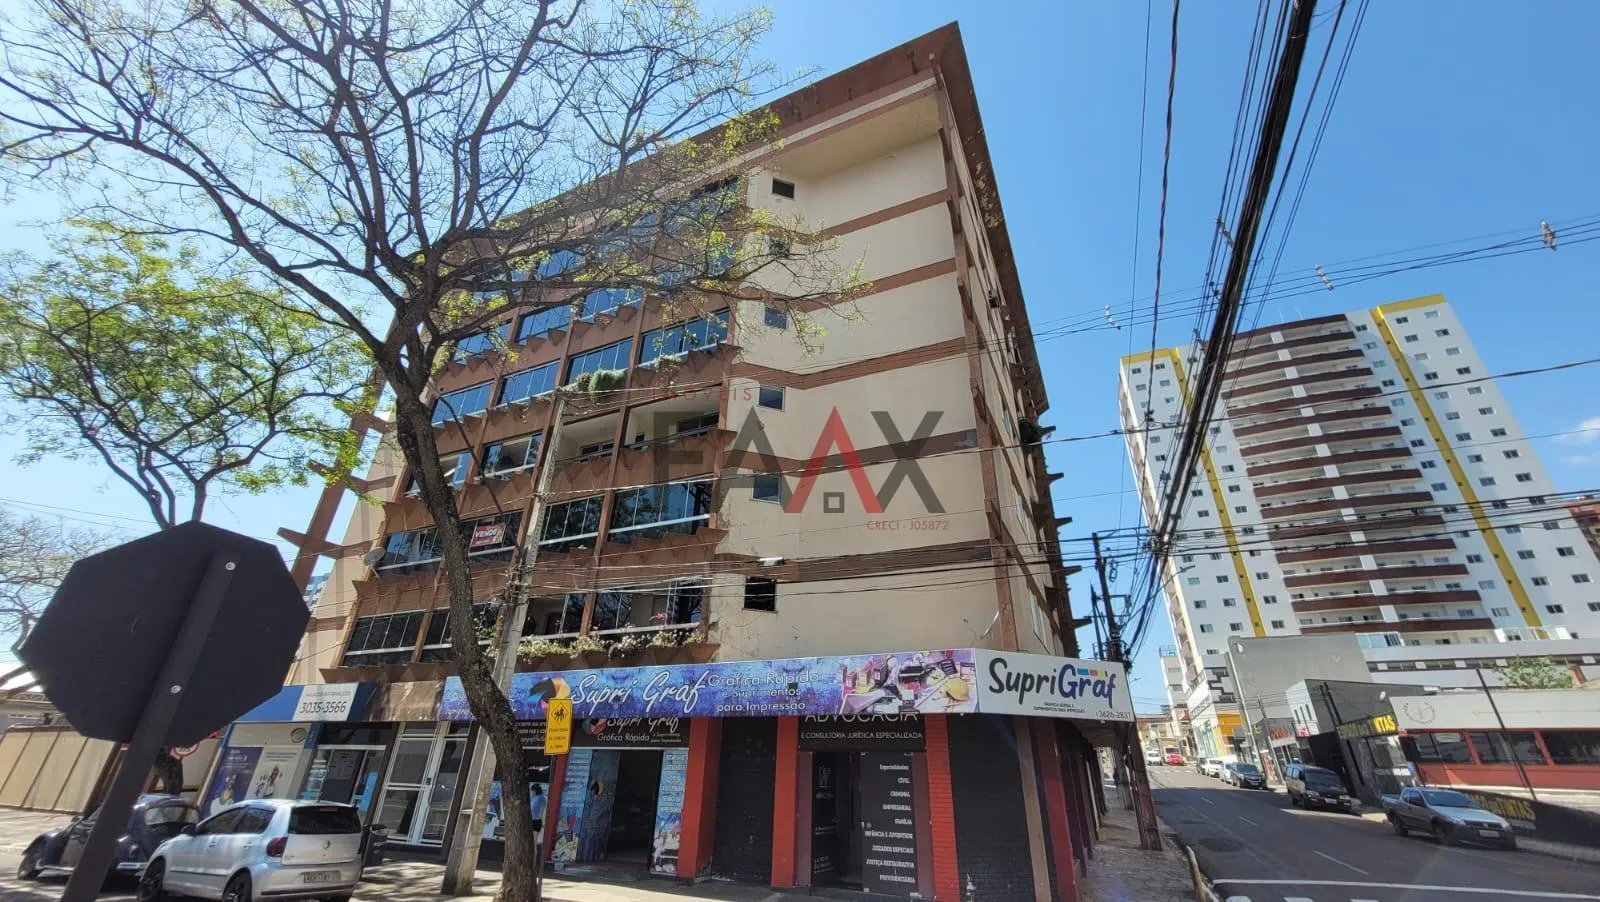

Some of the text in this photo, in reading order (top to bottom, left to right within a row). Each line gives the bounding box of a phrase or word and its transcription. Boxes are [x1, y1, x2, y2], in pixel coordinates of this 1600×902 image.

[571, 670, 710, 716] Supri Graf
[988, 657, 1117, 709] SupriGraf
[300, 701, 347, 713] 3035-3566
